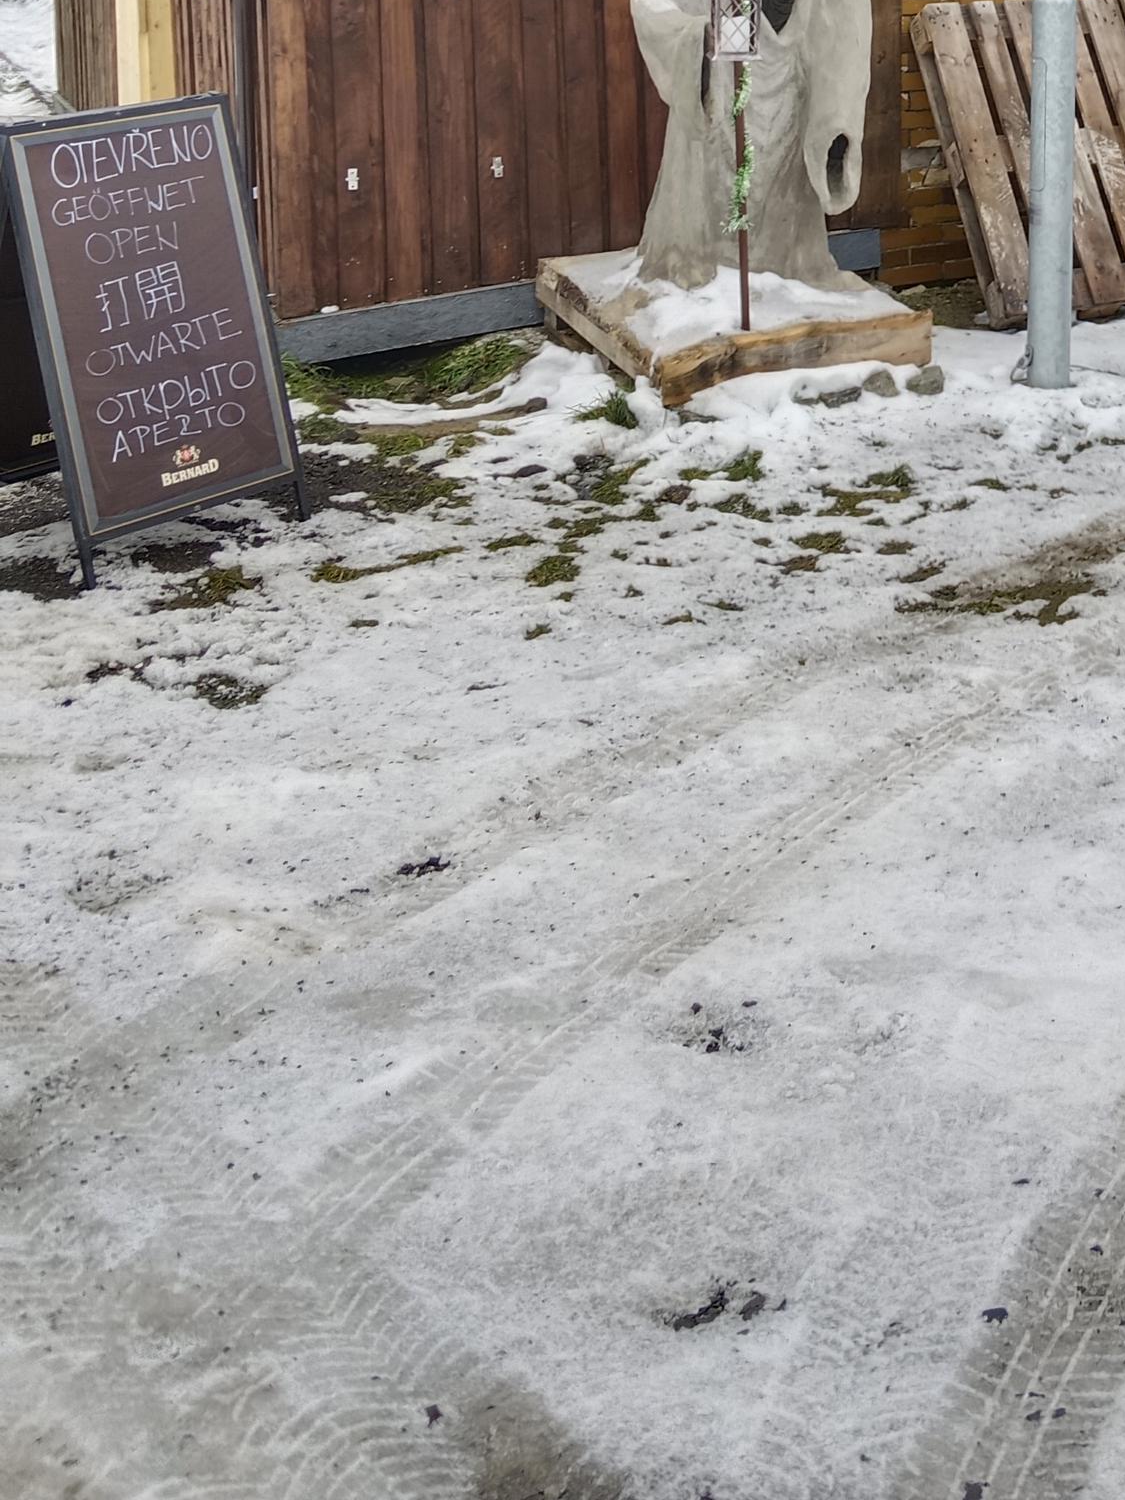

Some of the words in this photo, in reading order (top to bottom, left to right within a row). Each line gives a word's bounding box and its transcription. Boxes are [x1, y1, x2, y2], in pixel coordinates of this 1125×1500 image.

[50, 124, 213, 189] OTEVŘENO
[51, 175, 205, 227] GEÖFFNET
[84, 221, 179, 265] OPEN
[95, 260, 186, 333] 打開
[85, 307, 243, 377] OTWARTE
[160, 458, 220, 487] BERNARD
